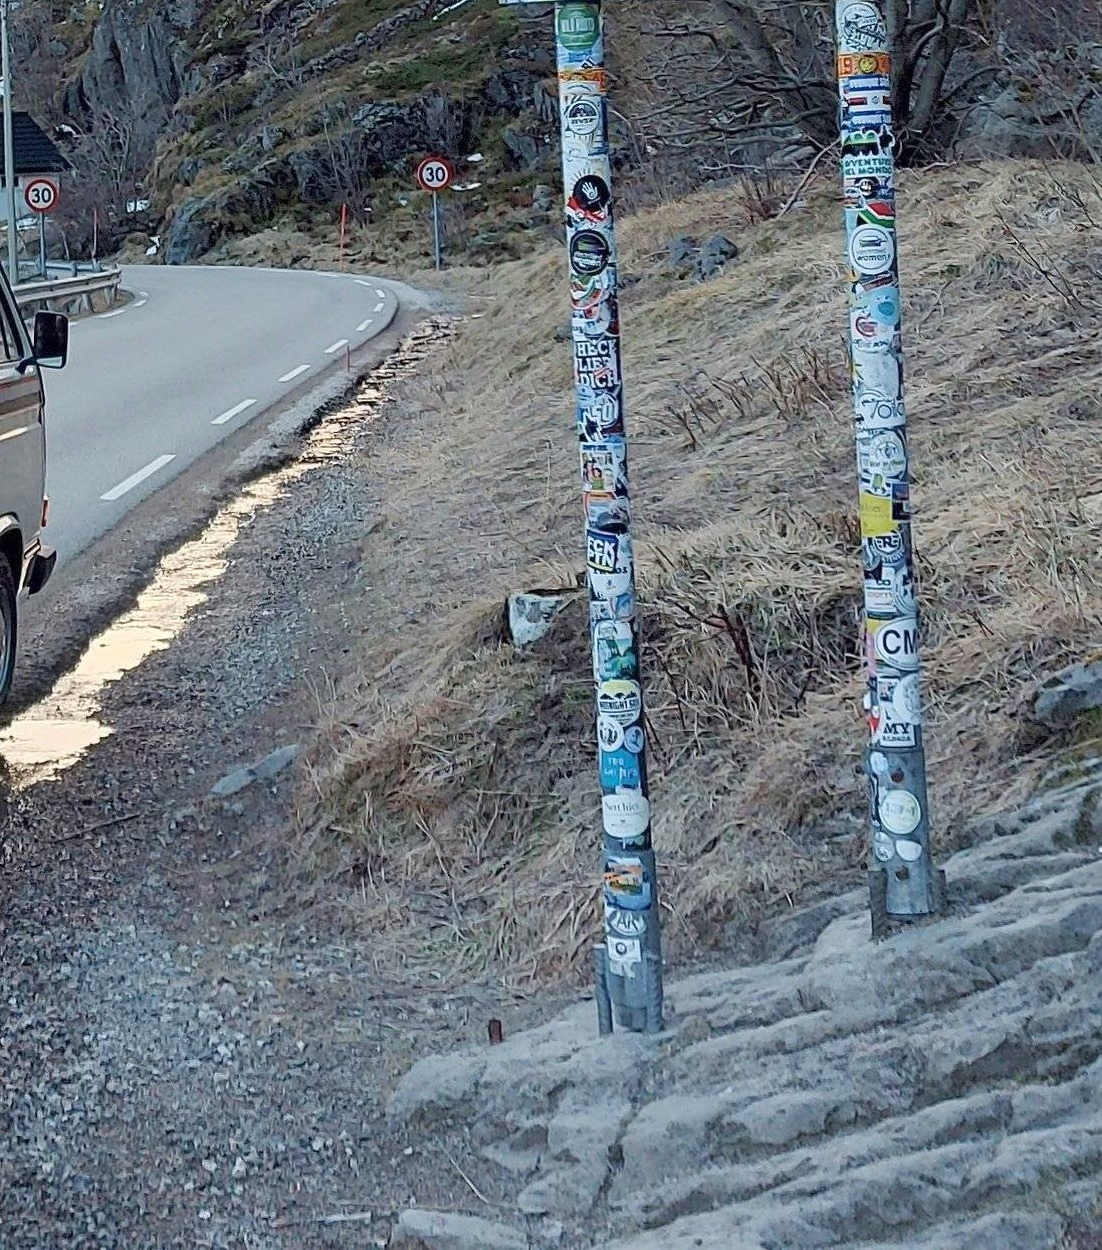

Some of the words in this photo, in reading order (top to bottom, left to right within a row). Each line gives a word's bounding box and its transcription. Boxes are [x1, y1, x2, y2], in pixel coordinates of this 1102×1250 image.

[426, 166, 445, 182] 30
[31, 187, 51, 203] 30
[883, 722, 910, 734] MY
